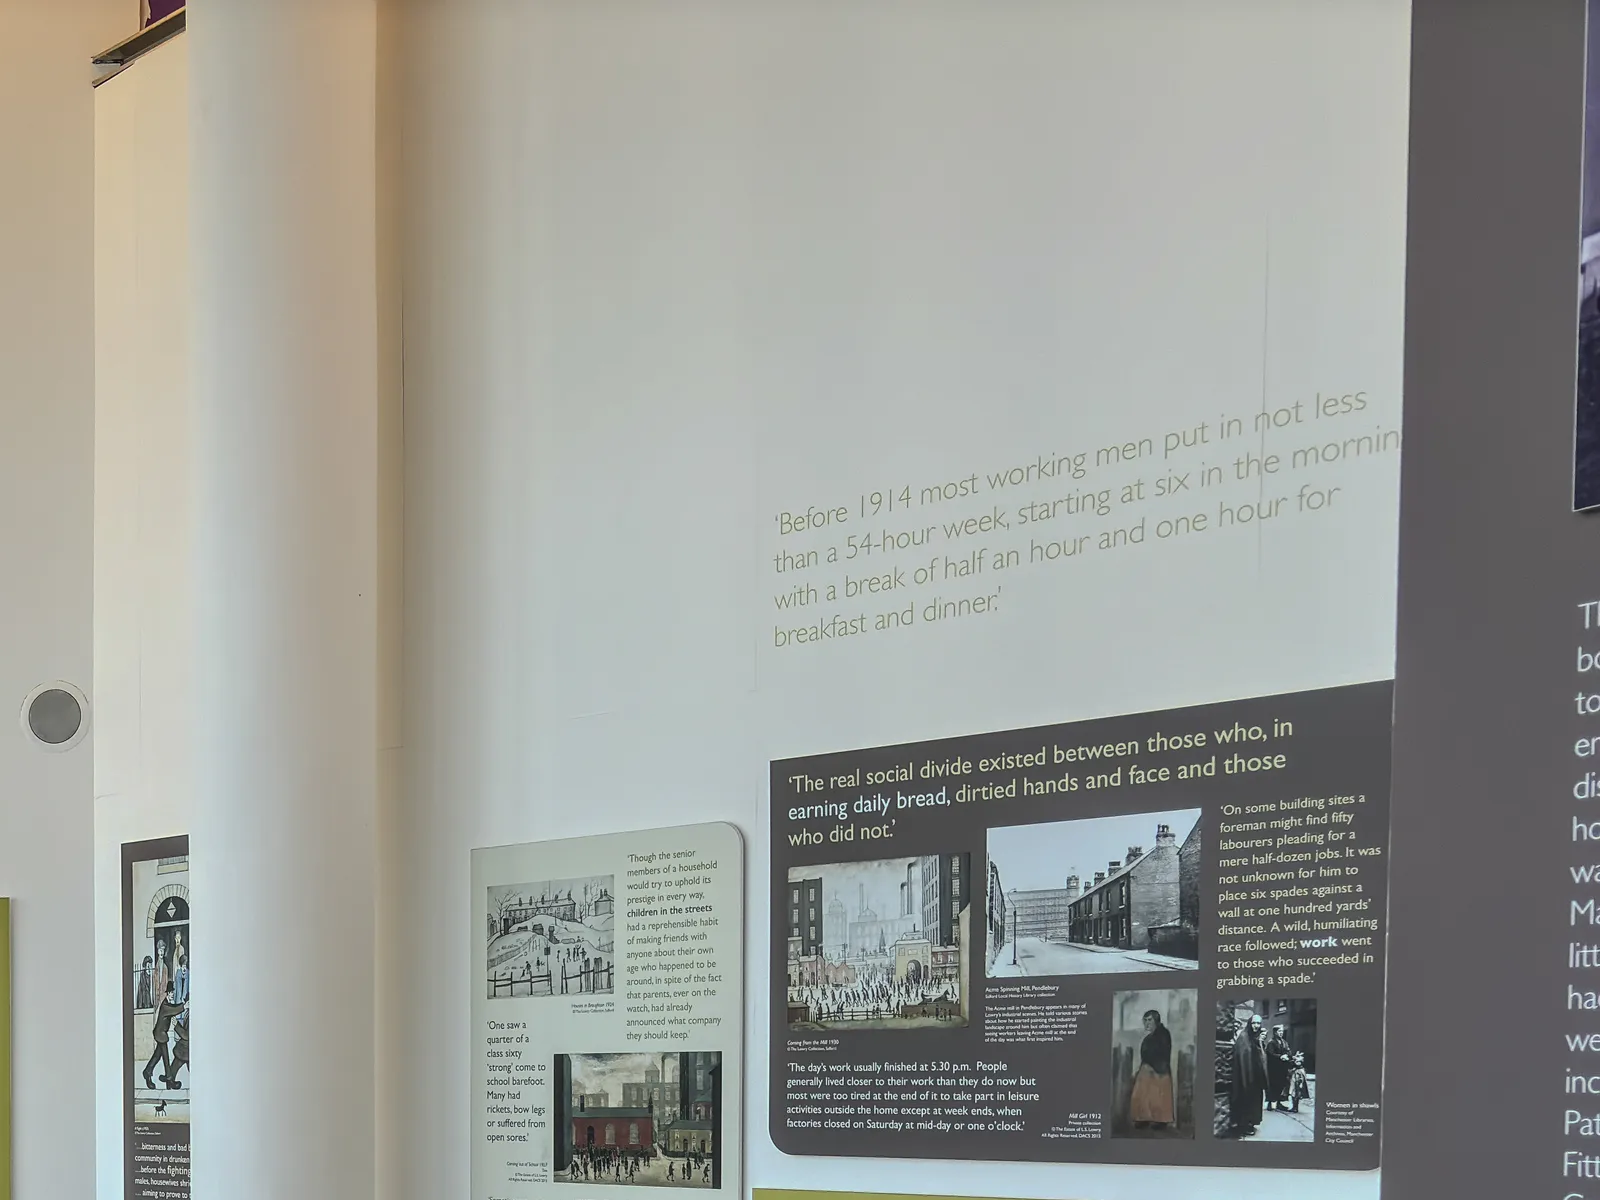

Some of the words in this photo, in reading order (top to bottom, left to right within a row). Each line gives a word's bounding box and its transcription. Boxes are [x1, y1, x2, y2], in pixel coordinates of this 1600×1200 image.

[860, 485, 911, 519] 1914
[921, 473, 978, 505] most
[987, 452, 1087, 489] working
[1097, 439, 1152, 466] men
[1165, 422, 1209, 459] put
[1221, 414, 1241, 439] in
[1254, 400, 1303, 432] not
[1316, 392, 1366, 419] less
[773, 550, 818, 573] than
[827, 547, 838, 563] a
[846, 527, 936, 559] 54-hour
[943, 506, 1009, 539] week,
[1018, 489, 1111, 524] starting
[1121, 479, 1145, 503] at
[1155, 469, 1189, 496] six
[1202, 462, 1222, 487] in
[1233, 452, 1280, 480] the
[1293, 431, 1398, 468] mornin
[774, 583, 817, 609] with
[826, 585, 837, 601] a
[846, 566, 905, 597] break
[914, 558, 939, 584] of
[945, 548, 987, 579] half
[993, 551, 1019, 570] an
[1031, 536, 1090, 563] hour
[1099, 517, 1145, 549] and
[1156, 514, 1207, 538] one
[1219, 497, 1288, 527] hour
[1297, 485, 1341, 511] for
[775, 613, 867, 647] breakfast
[875, 602, 913, 630] and
[789, 800, 847, 820] earning
[854, 793, 891, 816] daily
[897, 786, 950, 808] bread,
[956, 779, 1015, 802] dirtied
[1024, 773, 1078, 795] hands
[1086, 767, 1120, 789] and
[1129, 765, 1169, 784] face
[1178, 756, 1215, 779] and
[1224, 753, 1286, 774] those
[831, 769, 859, 789] real
[867, 762, 912, 784] social
[920, 757, 972, 778] divide
[979, 746, 1045, 771] existed
[1054, 741, 1138, 763] between
[1147, 732, 1206, 752] those
[1214, 722, 1267, 744] who,
[1275, 719, 1292, 737] in
[788, 828, 823, 846] who
[830, 824, 853, 842] did
[1245, 803, 1277, 814] some
[1279, 796, 1326, 811] building
[1328, 794, 1356, 806] sites
[1358, 794, 1366, 803] a
[626, 907, 659, 918] children
[660, 906, 668, 916] in
[669, 905, 683, 915] the
[684, 904, 713, 914] streets
